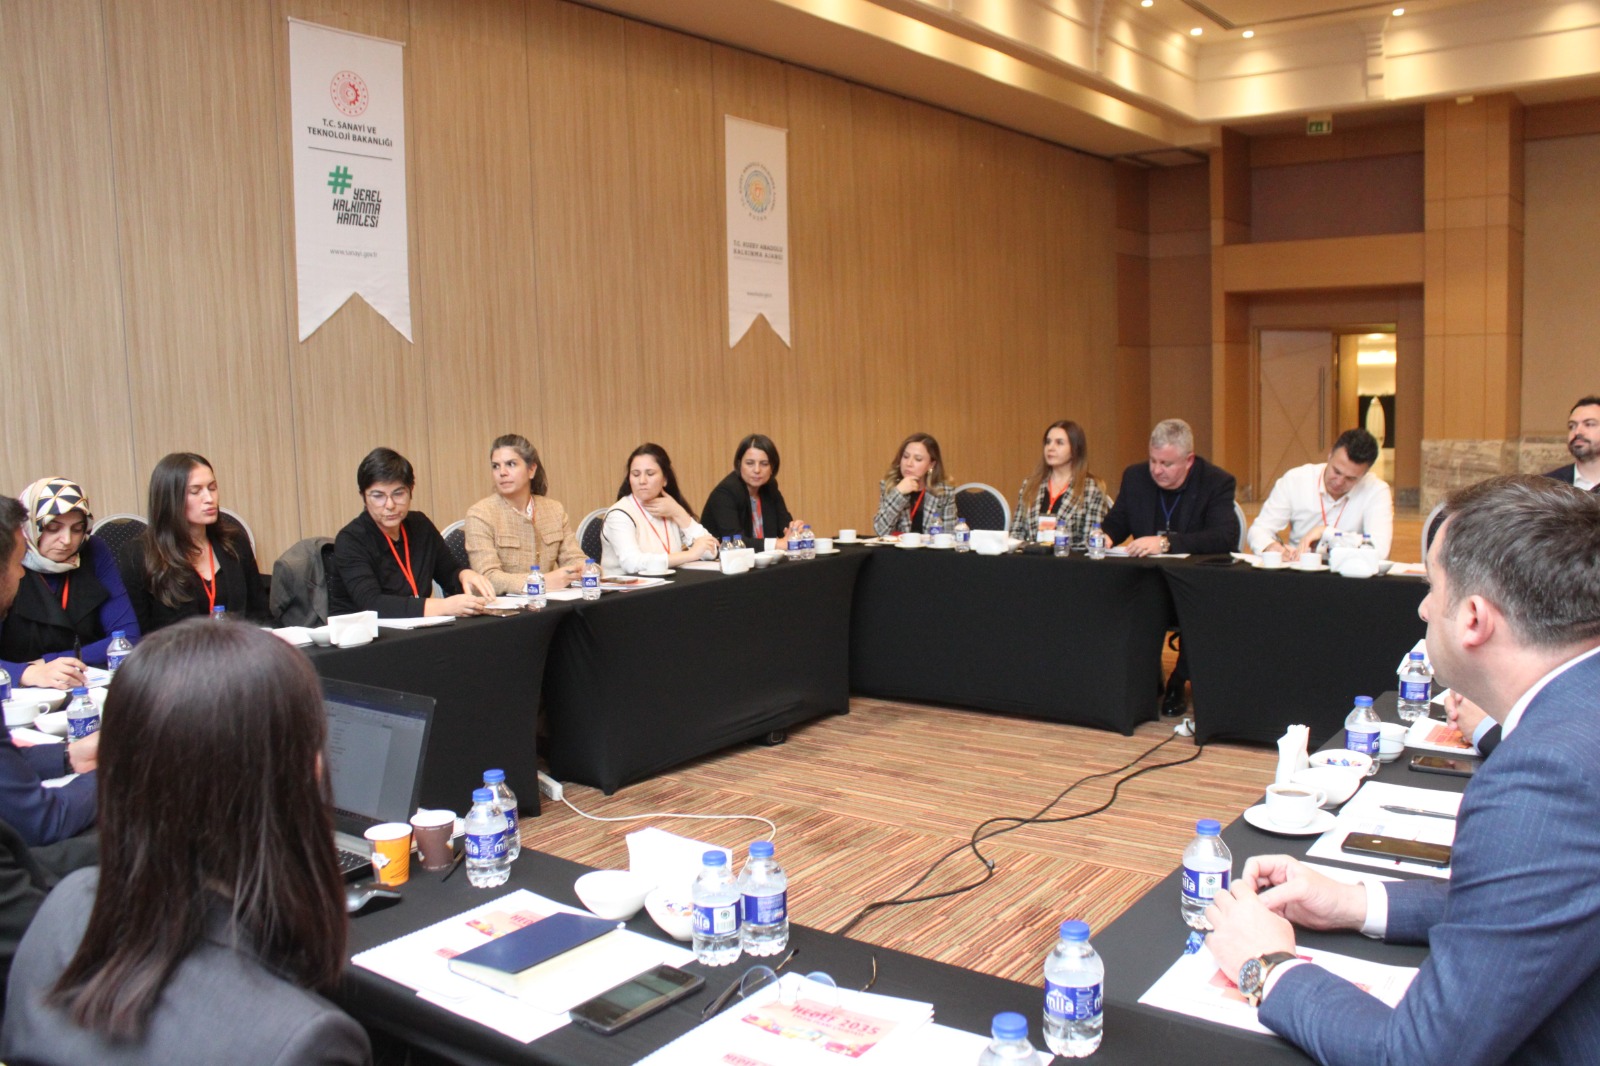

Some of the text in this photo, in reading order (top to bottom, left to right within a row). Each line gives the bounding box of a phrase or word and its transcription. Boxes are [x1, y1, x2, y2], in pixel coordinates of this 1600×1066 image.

[322, 118, 377, 134] T.C. SANAYİ VE
[307, 126, 393, 147] TEKNOLOJİ BAKANLIĞI
[353, 188, 382, 203] YEREL
[332, 198, 381, 215] KALKINMA
[1046, 995, 1074, 1014] mila
